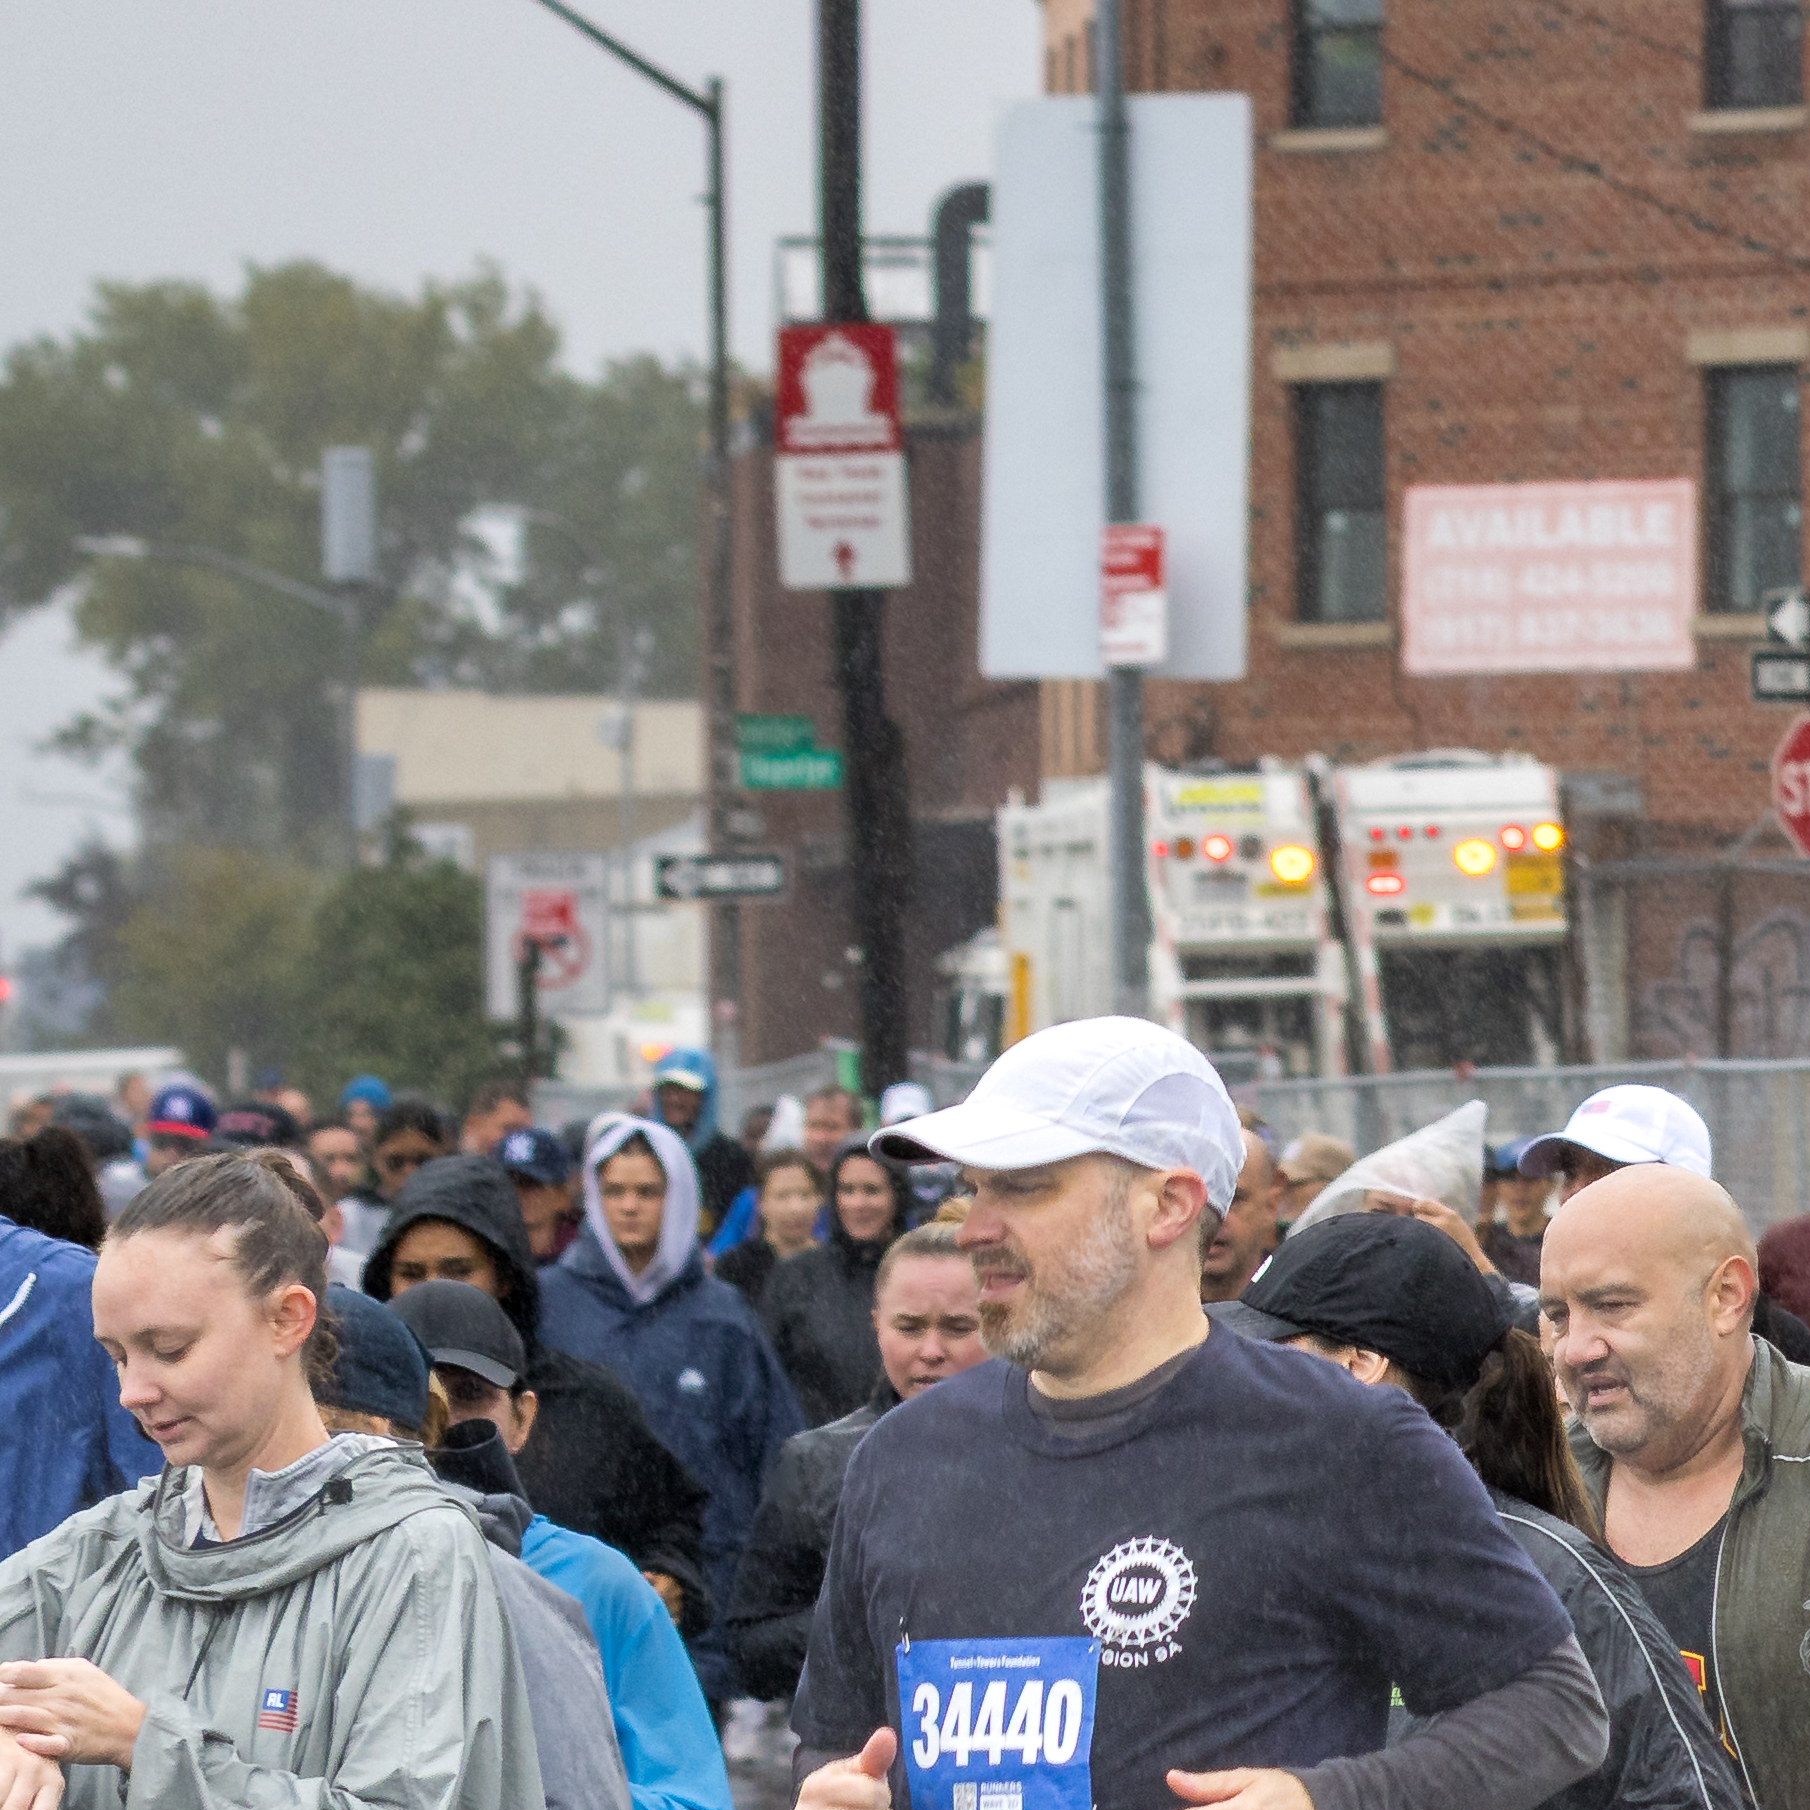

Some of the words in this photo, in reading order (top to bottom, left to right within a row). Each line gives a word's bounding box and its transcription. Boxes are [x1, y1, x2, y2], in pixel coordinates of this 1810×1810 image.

[1427, 502, 1674, 550] AVAILABLE
[1110, 1576, 1163, 1604] UAW
[1101, 1648, 1149, 1669] GION
[912, 1679, 1084, 1769] 34440
